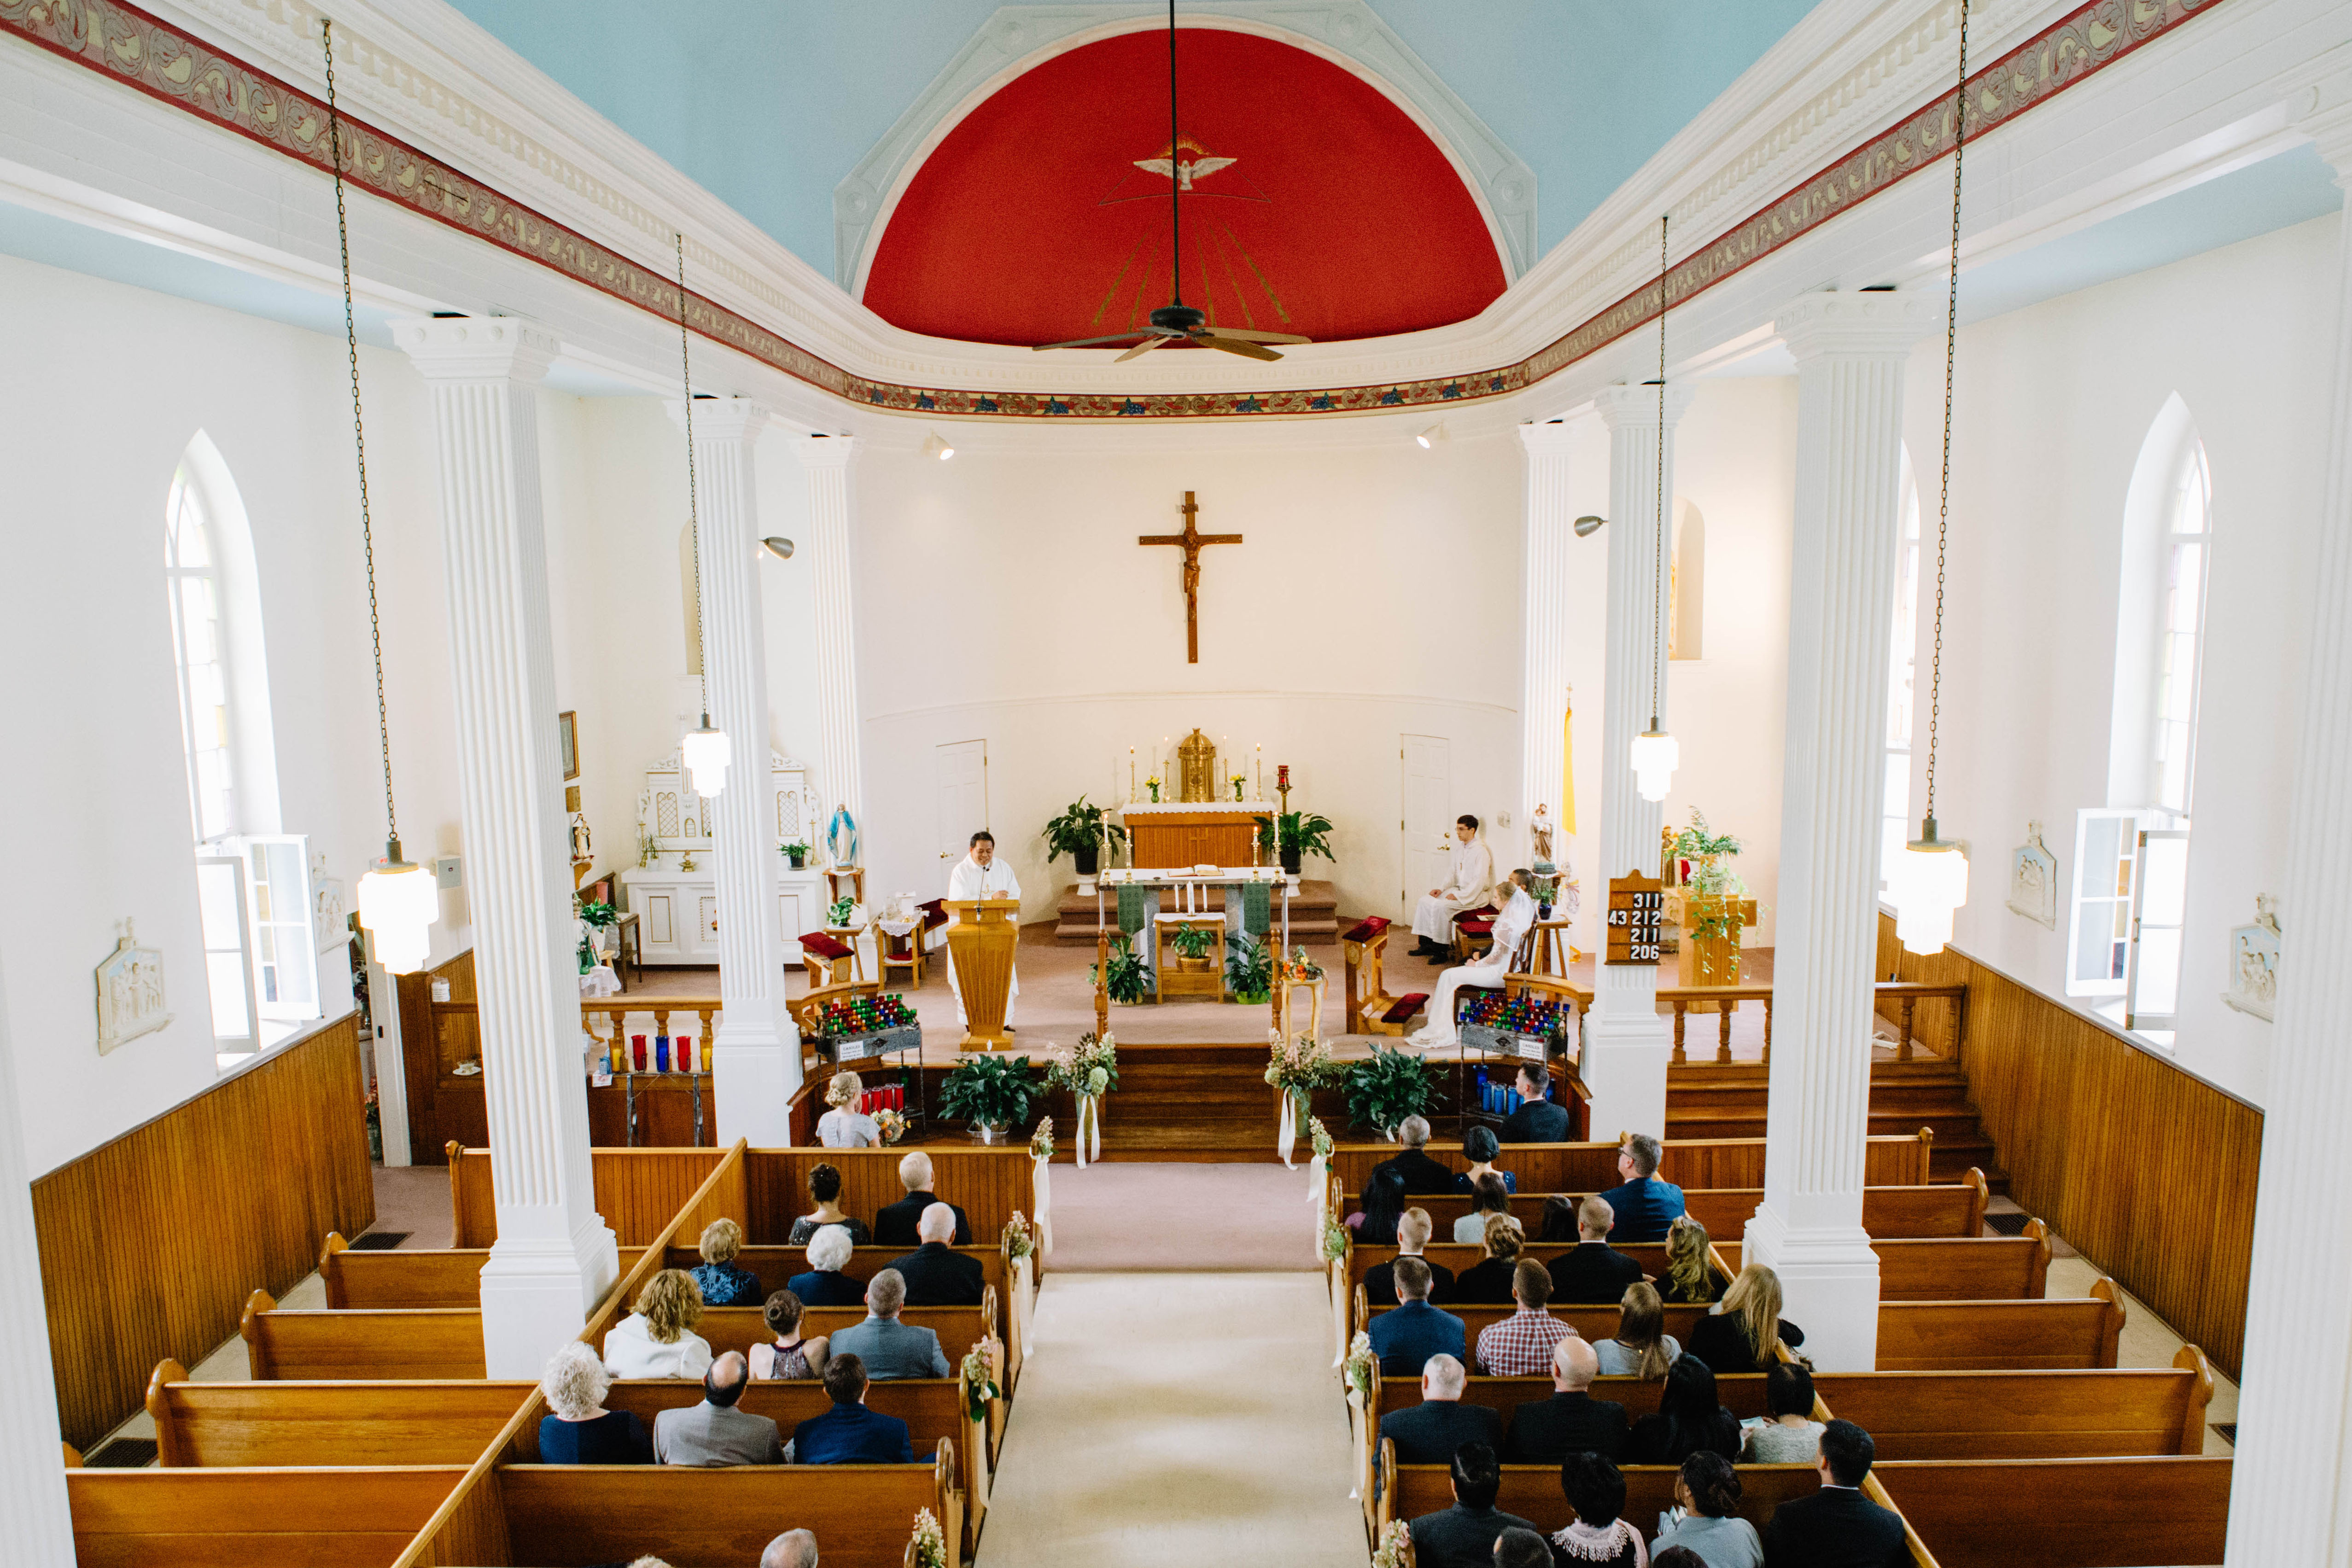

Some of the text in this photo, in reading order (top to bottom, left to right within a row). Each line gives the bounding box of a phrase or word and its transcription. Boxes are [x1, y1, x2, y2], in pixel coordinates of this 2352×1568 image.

[1634, 893, 1659, 908] 311
[1608, 910, 1661, 925] 43 212
[1630, 928, 1657, 942] 211
[1630, 945, 1659, 959] 206
